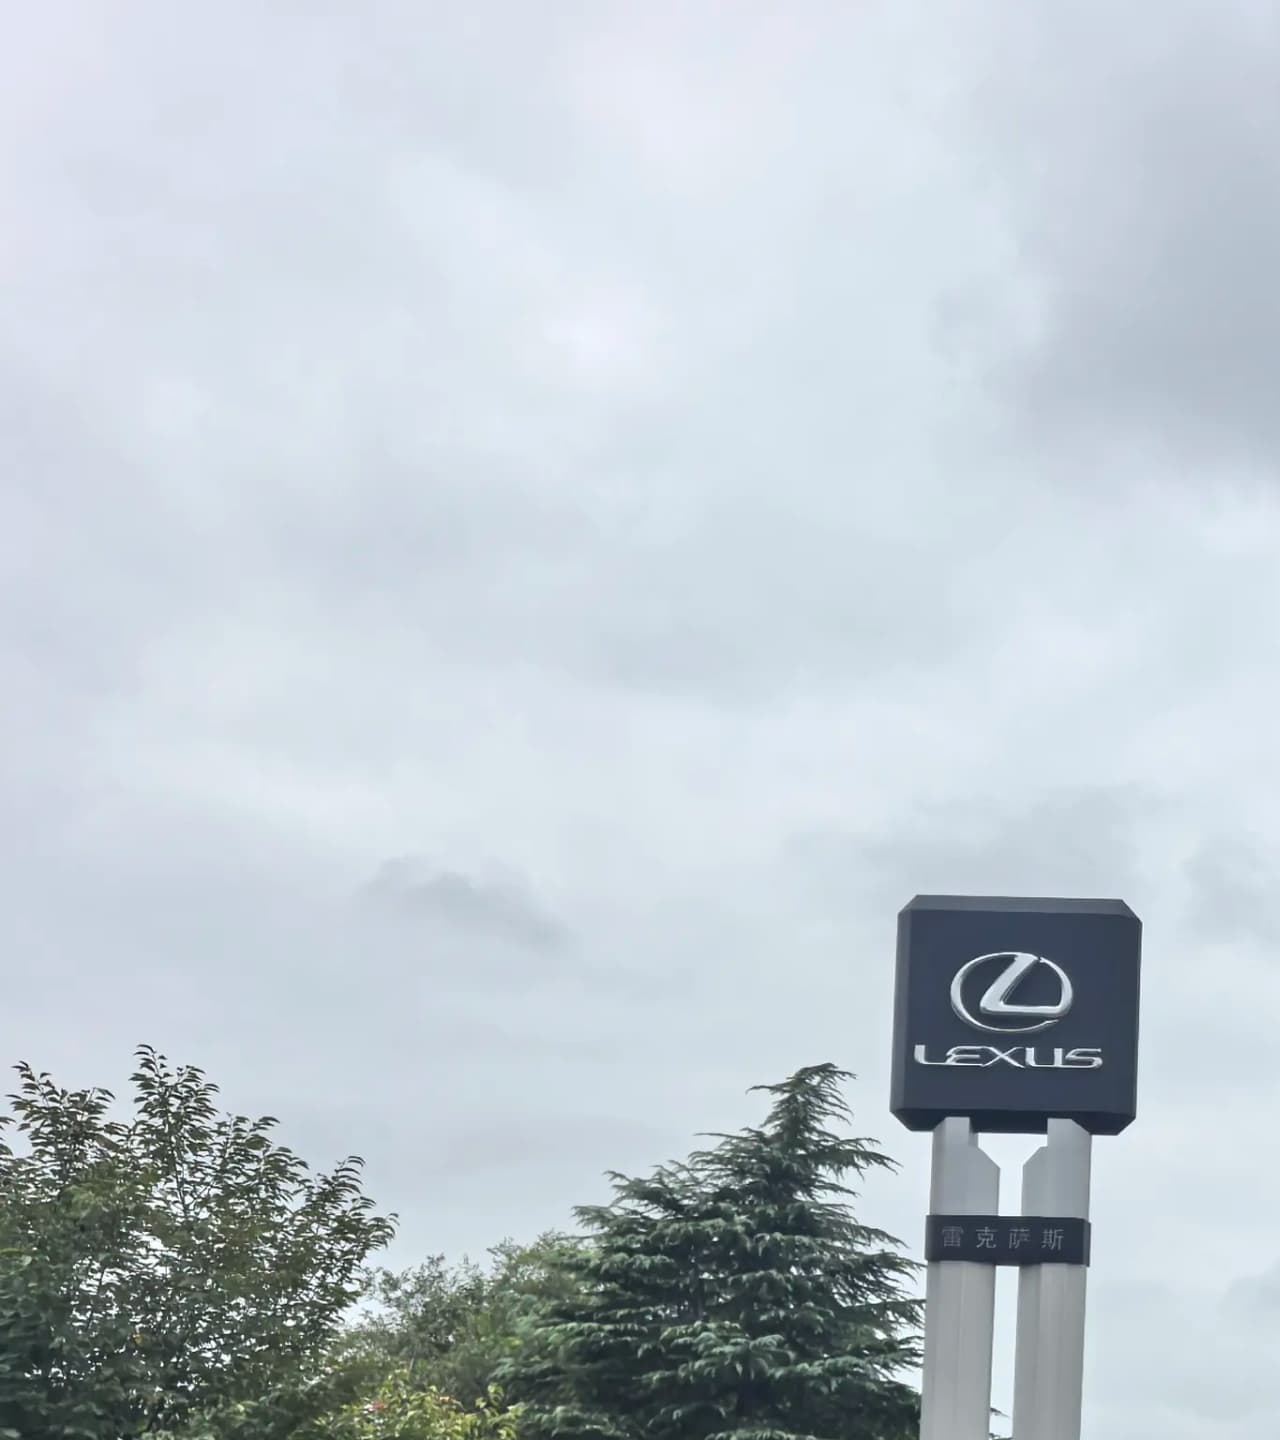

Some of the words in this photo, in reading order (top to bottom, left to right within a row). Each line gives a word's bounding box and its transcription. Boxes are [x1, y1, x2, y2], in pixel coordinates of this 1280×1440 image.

[914, 1044, 1103, 1069] LEXUS
[941, 1226, 1065, 1250] 雷克萨斯
